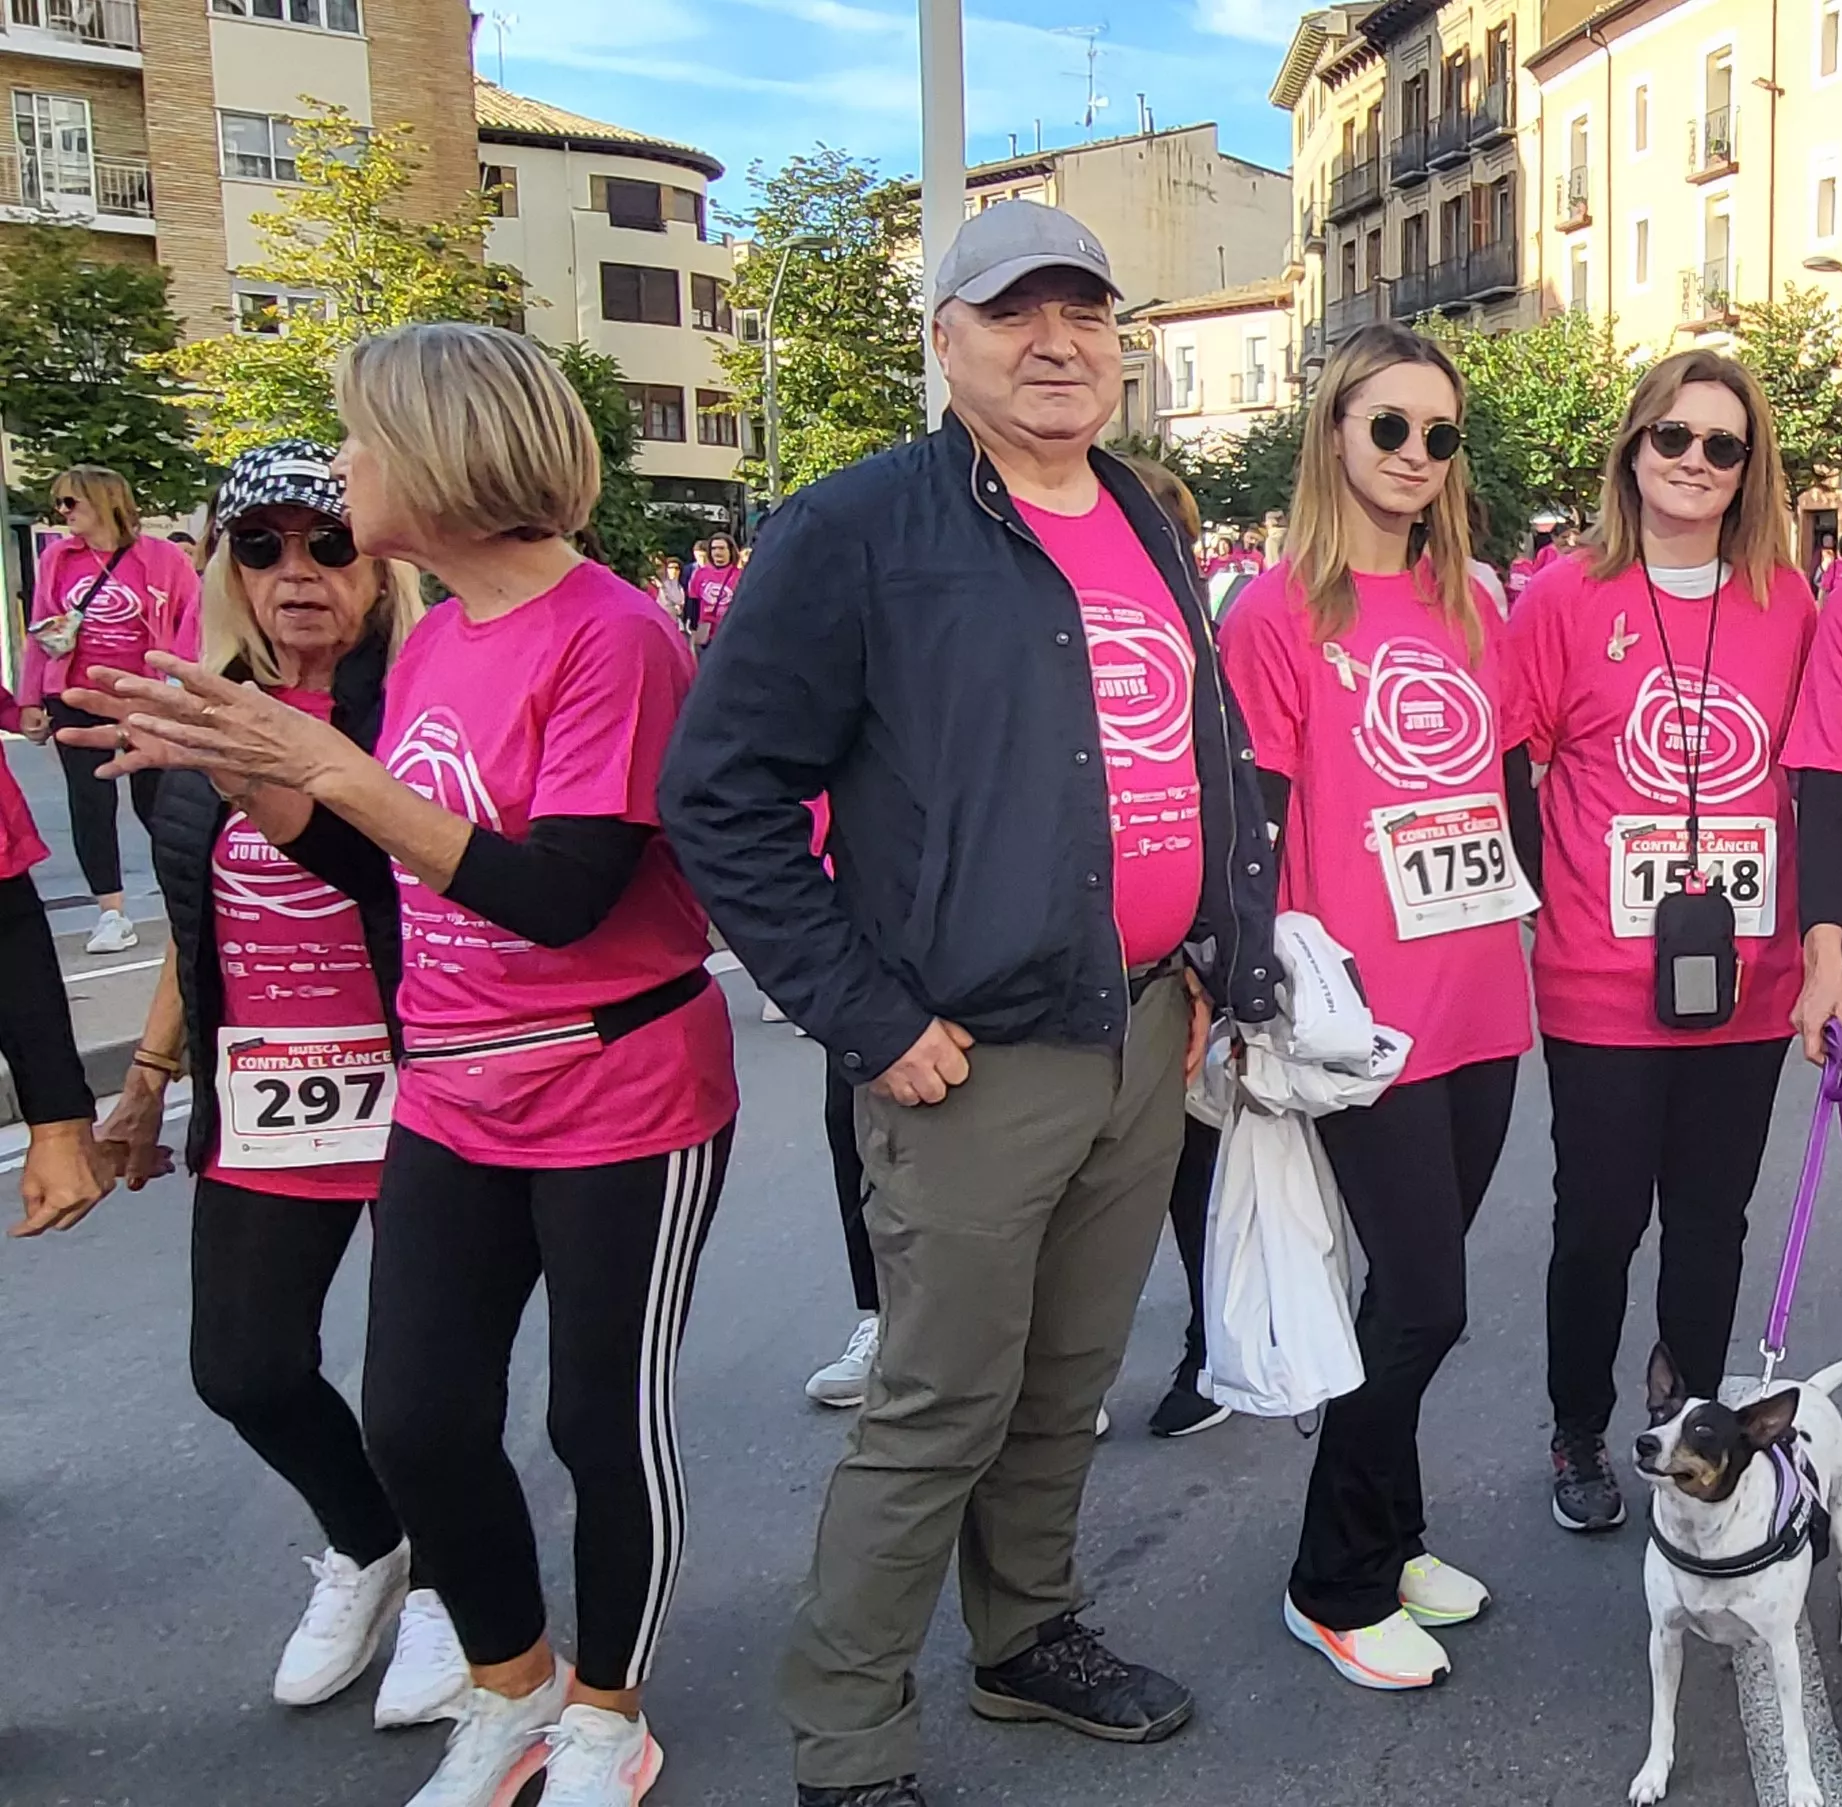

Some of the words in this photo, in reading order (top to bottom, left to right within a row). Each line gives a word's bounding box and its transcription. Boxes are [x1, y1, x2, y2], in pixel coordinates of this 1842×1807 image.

[1631, 840, 1687, 852] CONTRA
[1707, 838, 1759, 853] CÁNCER
[1403, 837, 1506, 896] 1759
[237, 1056, 304, 1071] CONTRA
[308, 1054, 328, 1068] EL
[333, 1048, 392, 1066] CÁNCE
[288, 1043, 341, 1055] HUESCA
[253, 1072, 387, 1129] 297
